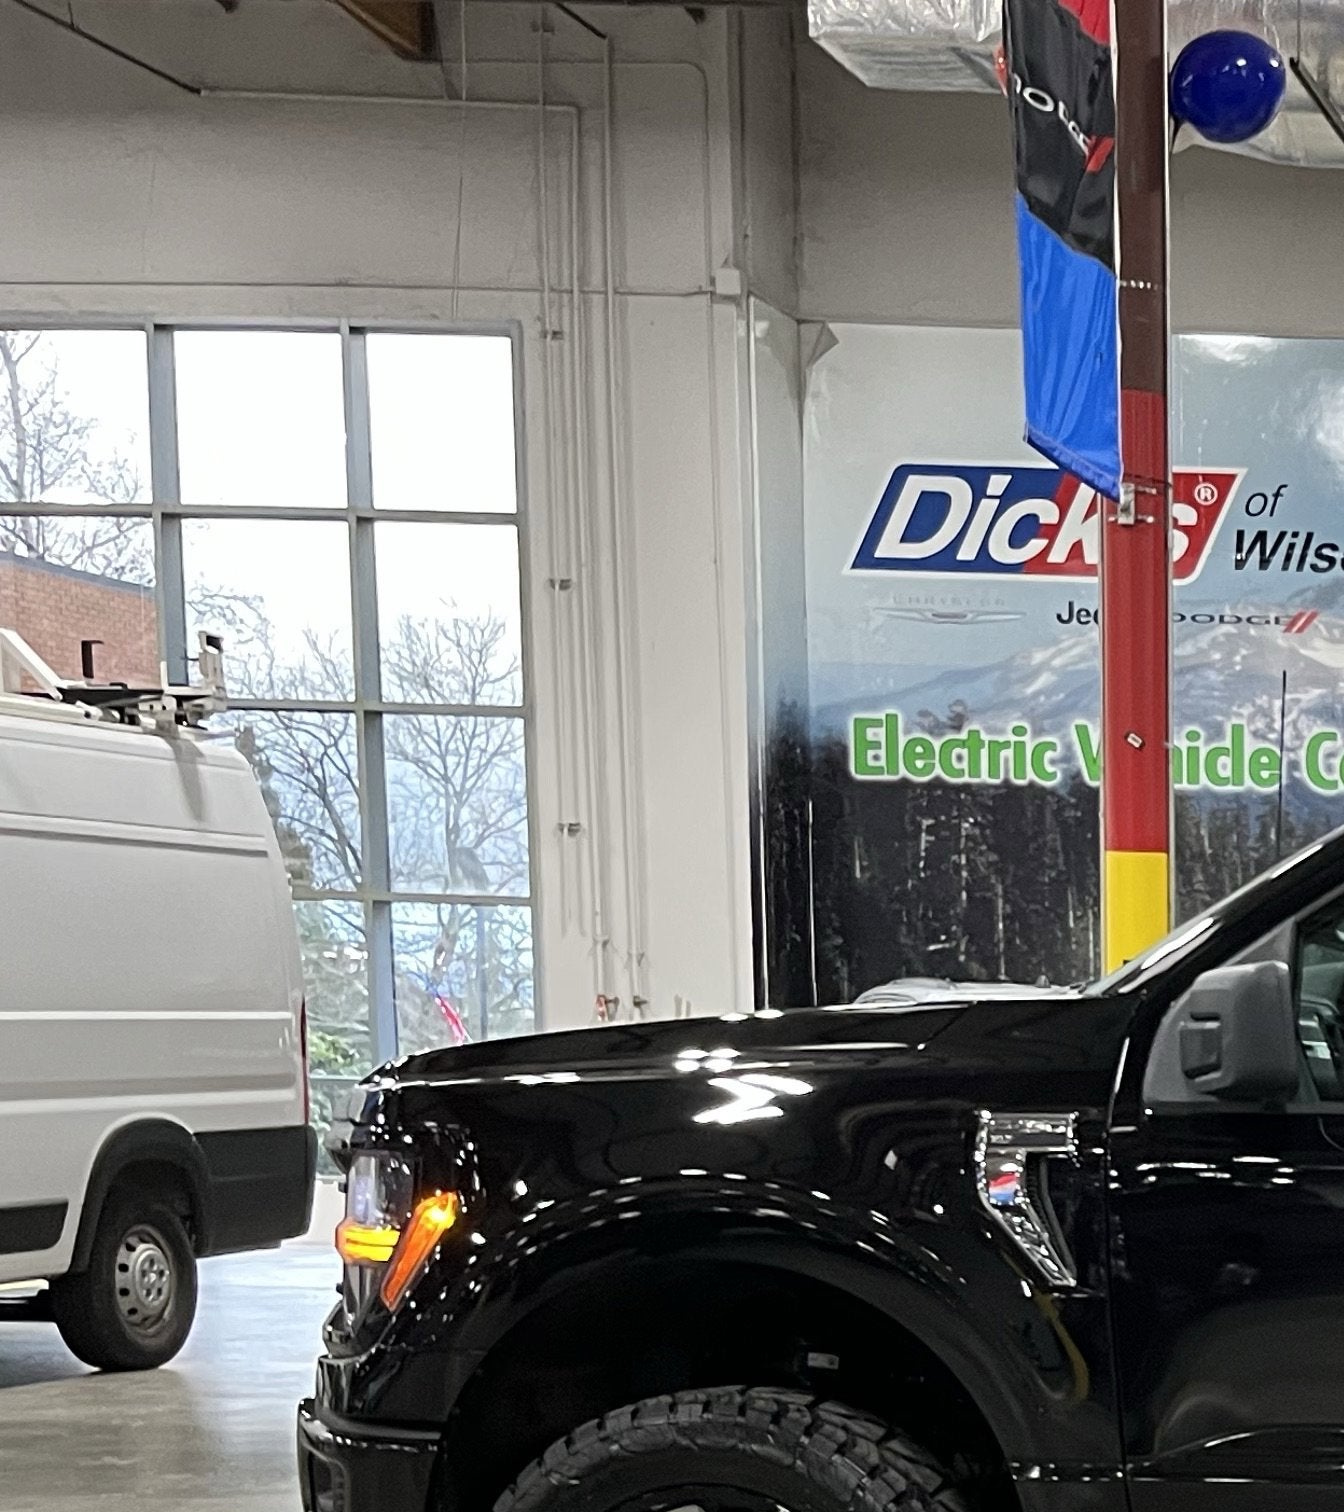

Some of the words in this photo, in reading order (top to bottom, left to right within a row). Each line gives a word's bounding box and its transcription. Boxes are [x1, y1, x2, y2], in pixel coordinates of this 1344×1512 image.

[874, 474, 1199, 566] Dicks
[1245, 484, 1288, 517] of
[853, 713, 1058, 782] Electric
[1074, 724, 1281, 787] Vicle
